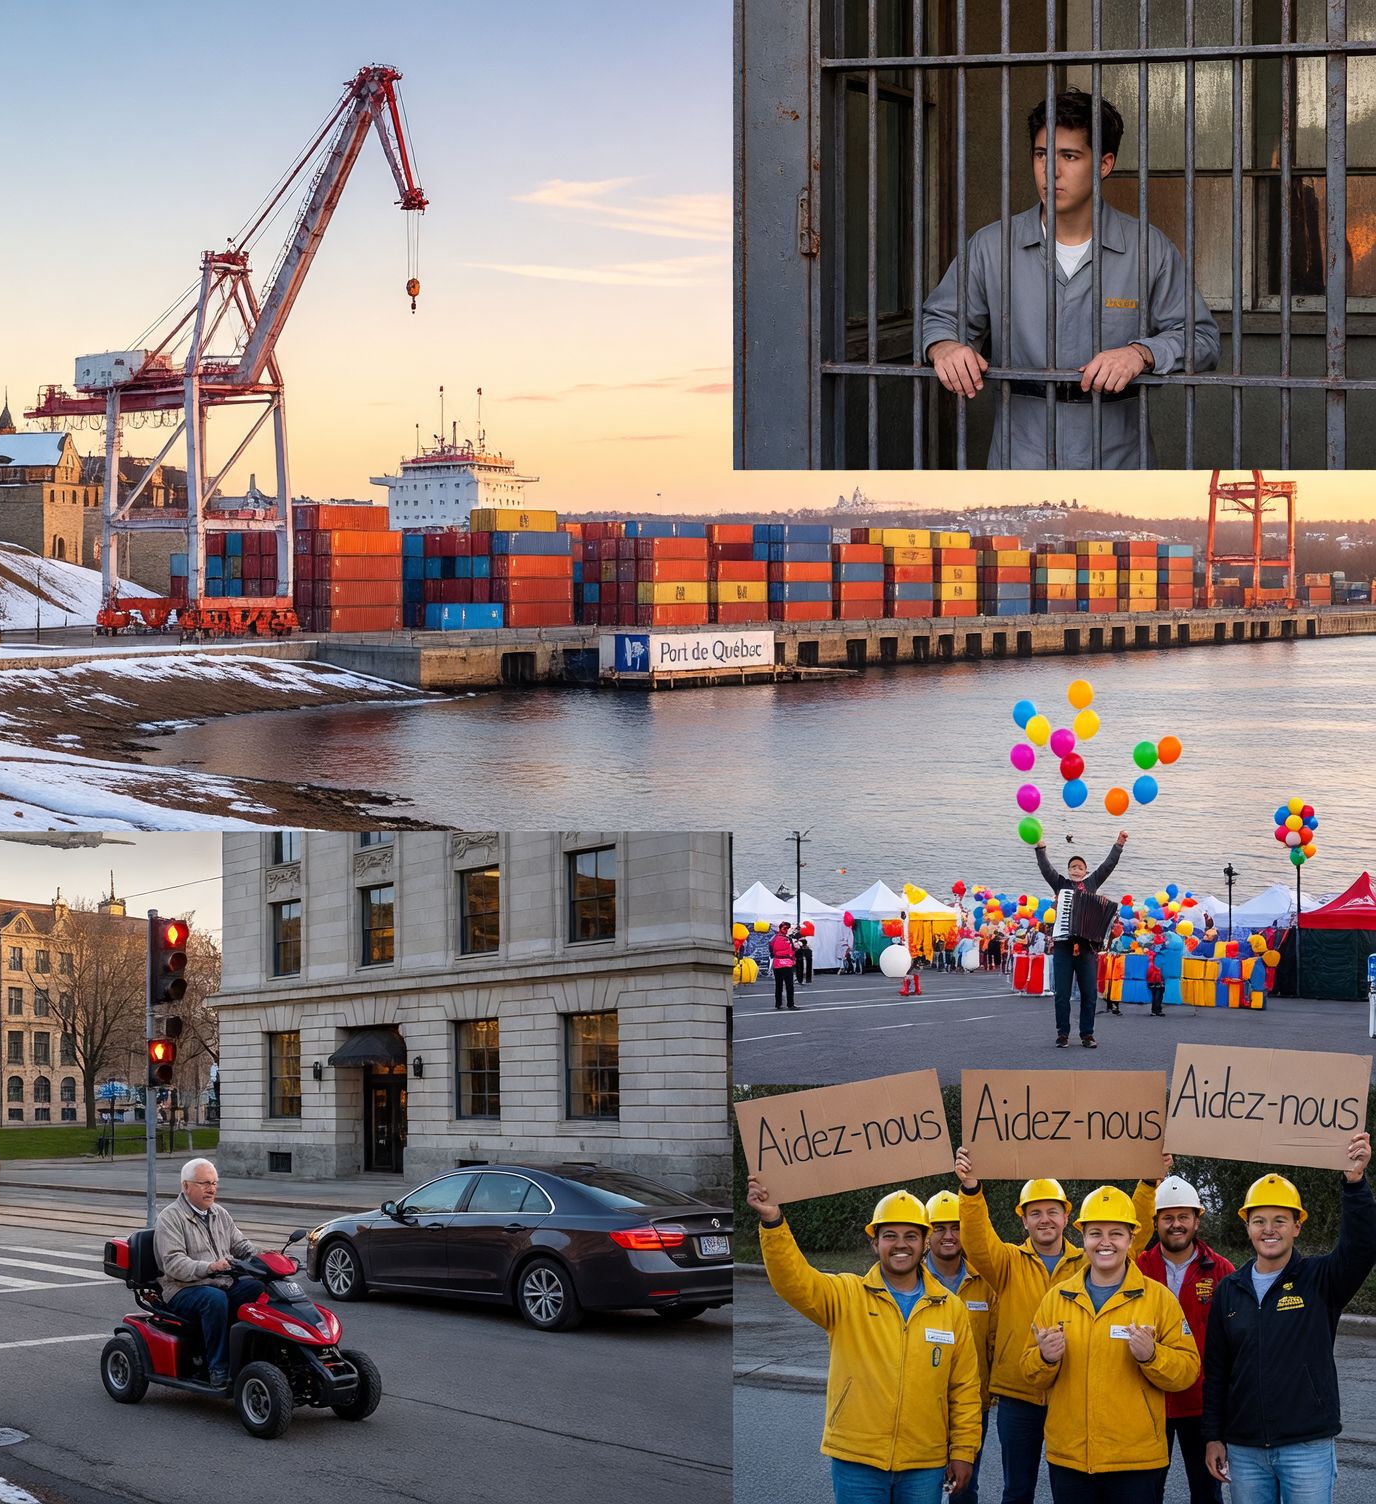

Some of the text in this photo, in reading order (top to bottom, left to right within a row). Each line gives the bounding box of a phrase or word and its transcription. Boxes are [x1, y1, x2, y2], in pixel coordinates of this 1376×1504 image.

[660, 638, 762, 663] Port de Québec
[971, 1083, 1162, 1142] Aidez-nous
[1173, 1063, 1360, 1131] Aidez-nous
[758, 1109, 942, 1171] Aidez-nous
